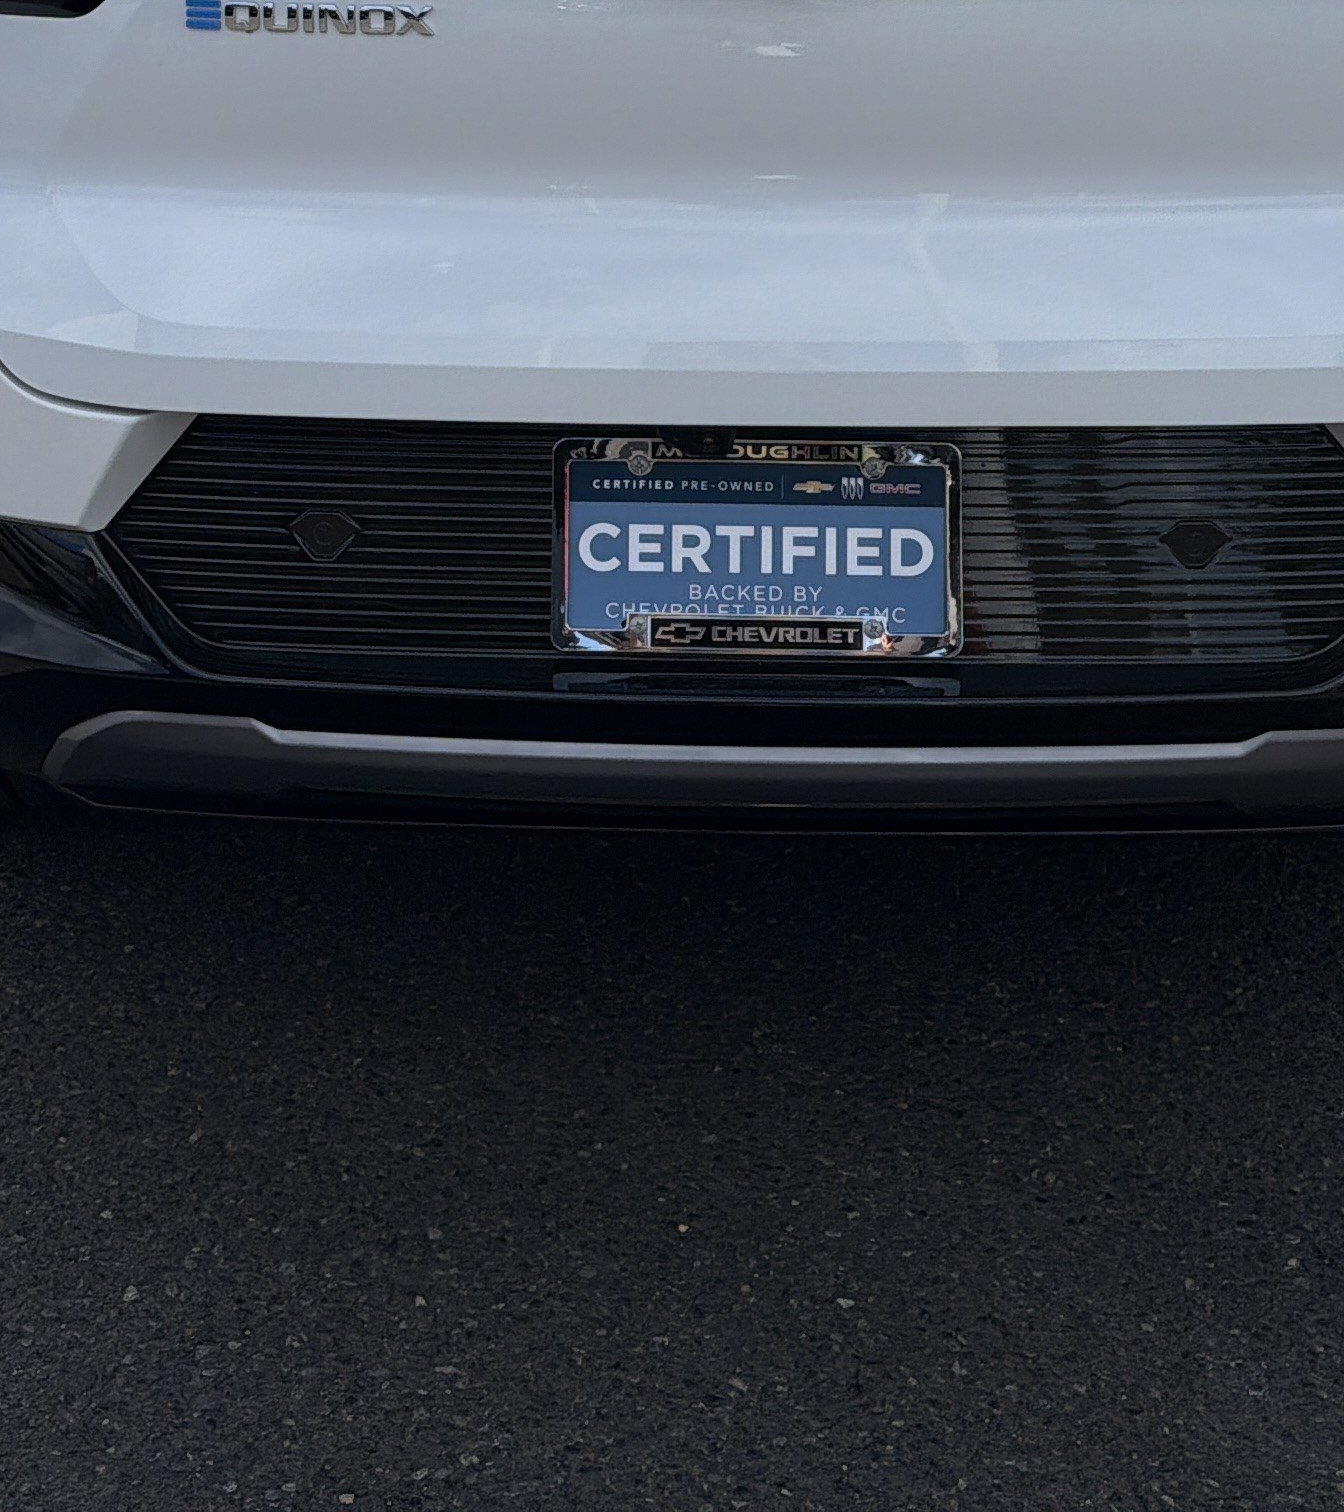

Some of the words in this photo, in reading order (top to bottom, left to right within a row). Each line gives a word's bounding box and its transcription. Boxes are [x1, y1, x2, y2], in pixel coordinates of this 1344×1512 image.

[591, 478, 675, 490] CERTIFIED
[681, 480, 774, 493] PRE-OWNED
[869, 483, 921, 495] GMC
[577, 522, 935, 577] CERTIFIED
[688, 584, 783, 602] BACKED
[793, 586, 823, 602] BY
[711, 625, 860, 644] CHEVROLET
